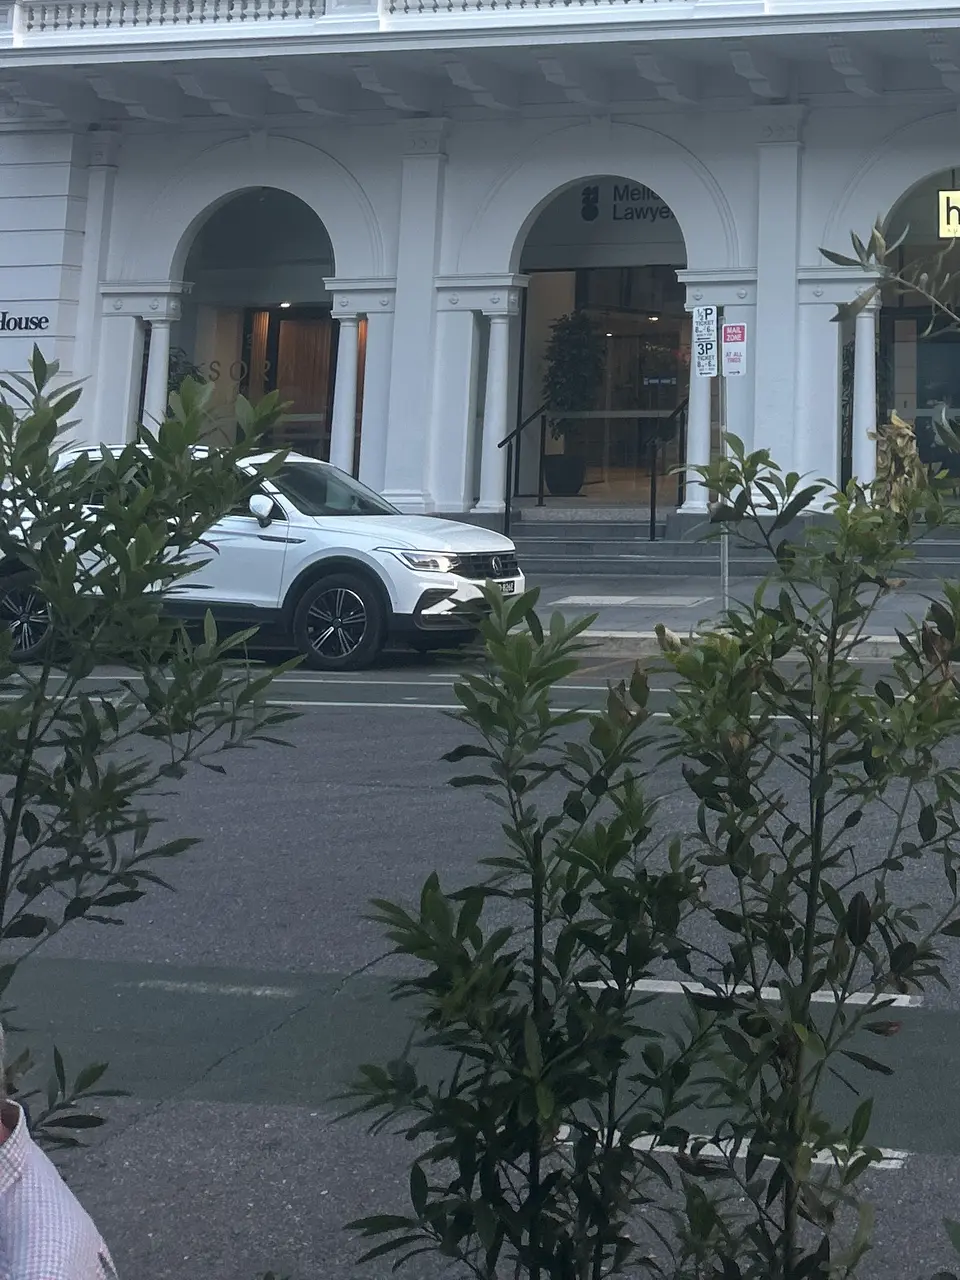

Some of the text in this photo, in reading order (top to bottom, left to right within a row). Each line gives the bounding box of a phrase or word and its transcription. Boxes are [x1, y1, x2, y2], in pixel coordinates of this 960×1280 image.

[613, 203, 677, 222] Lawye
[726, 326, 742, 334] MAIL
[697, 342, 713, 355] 3P
